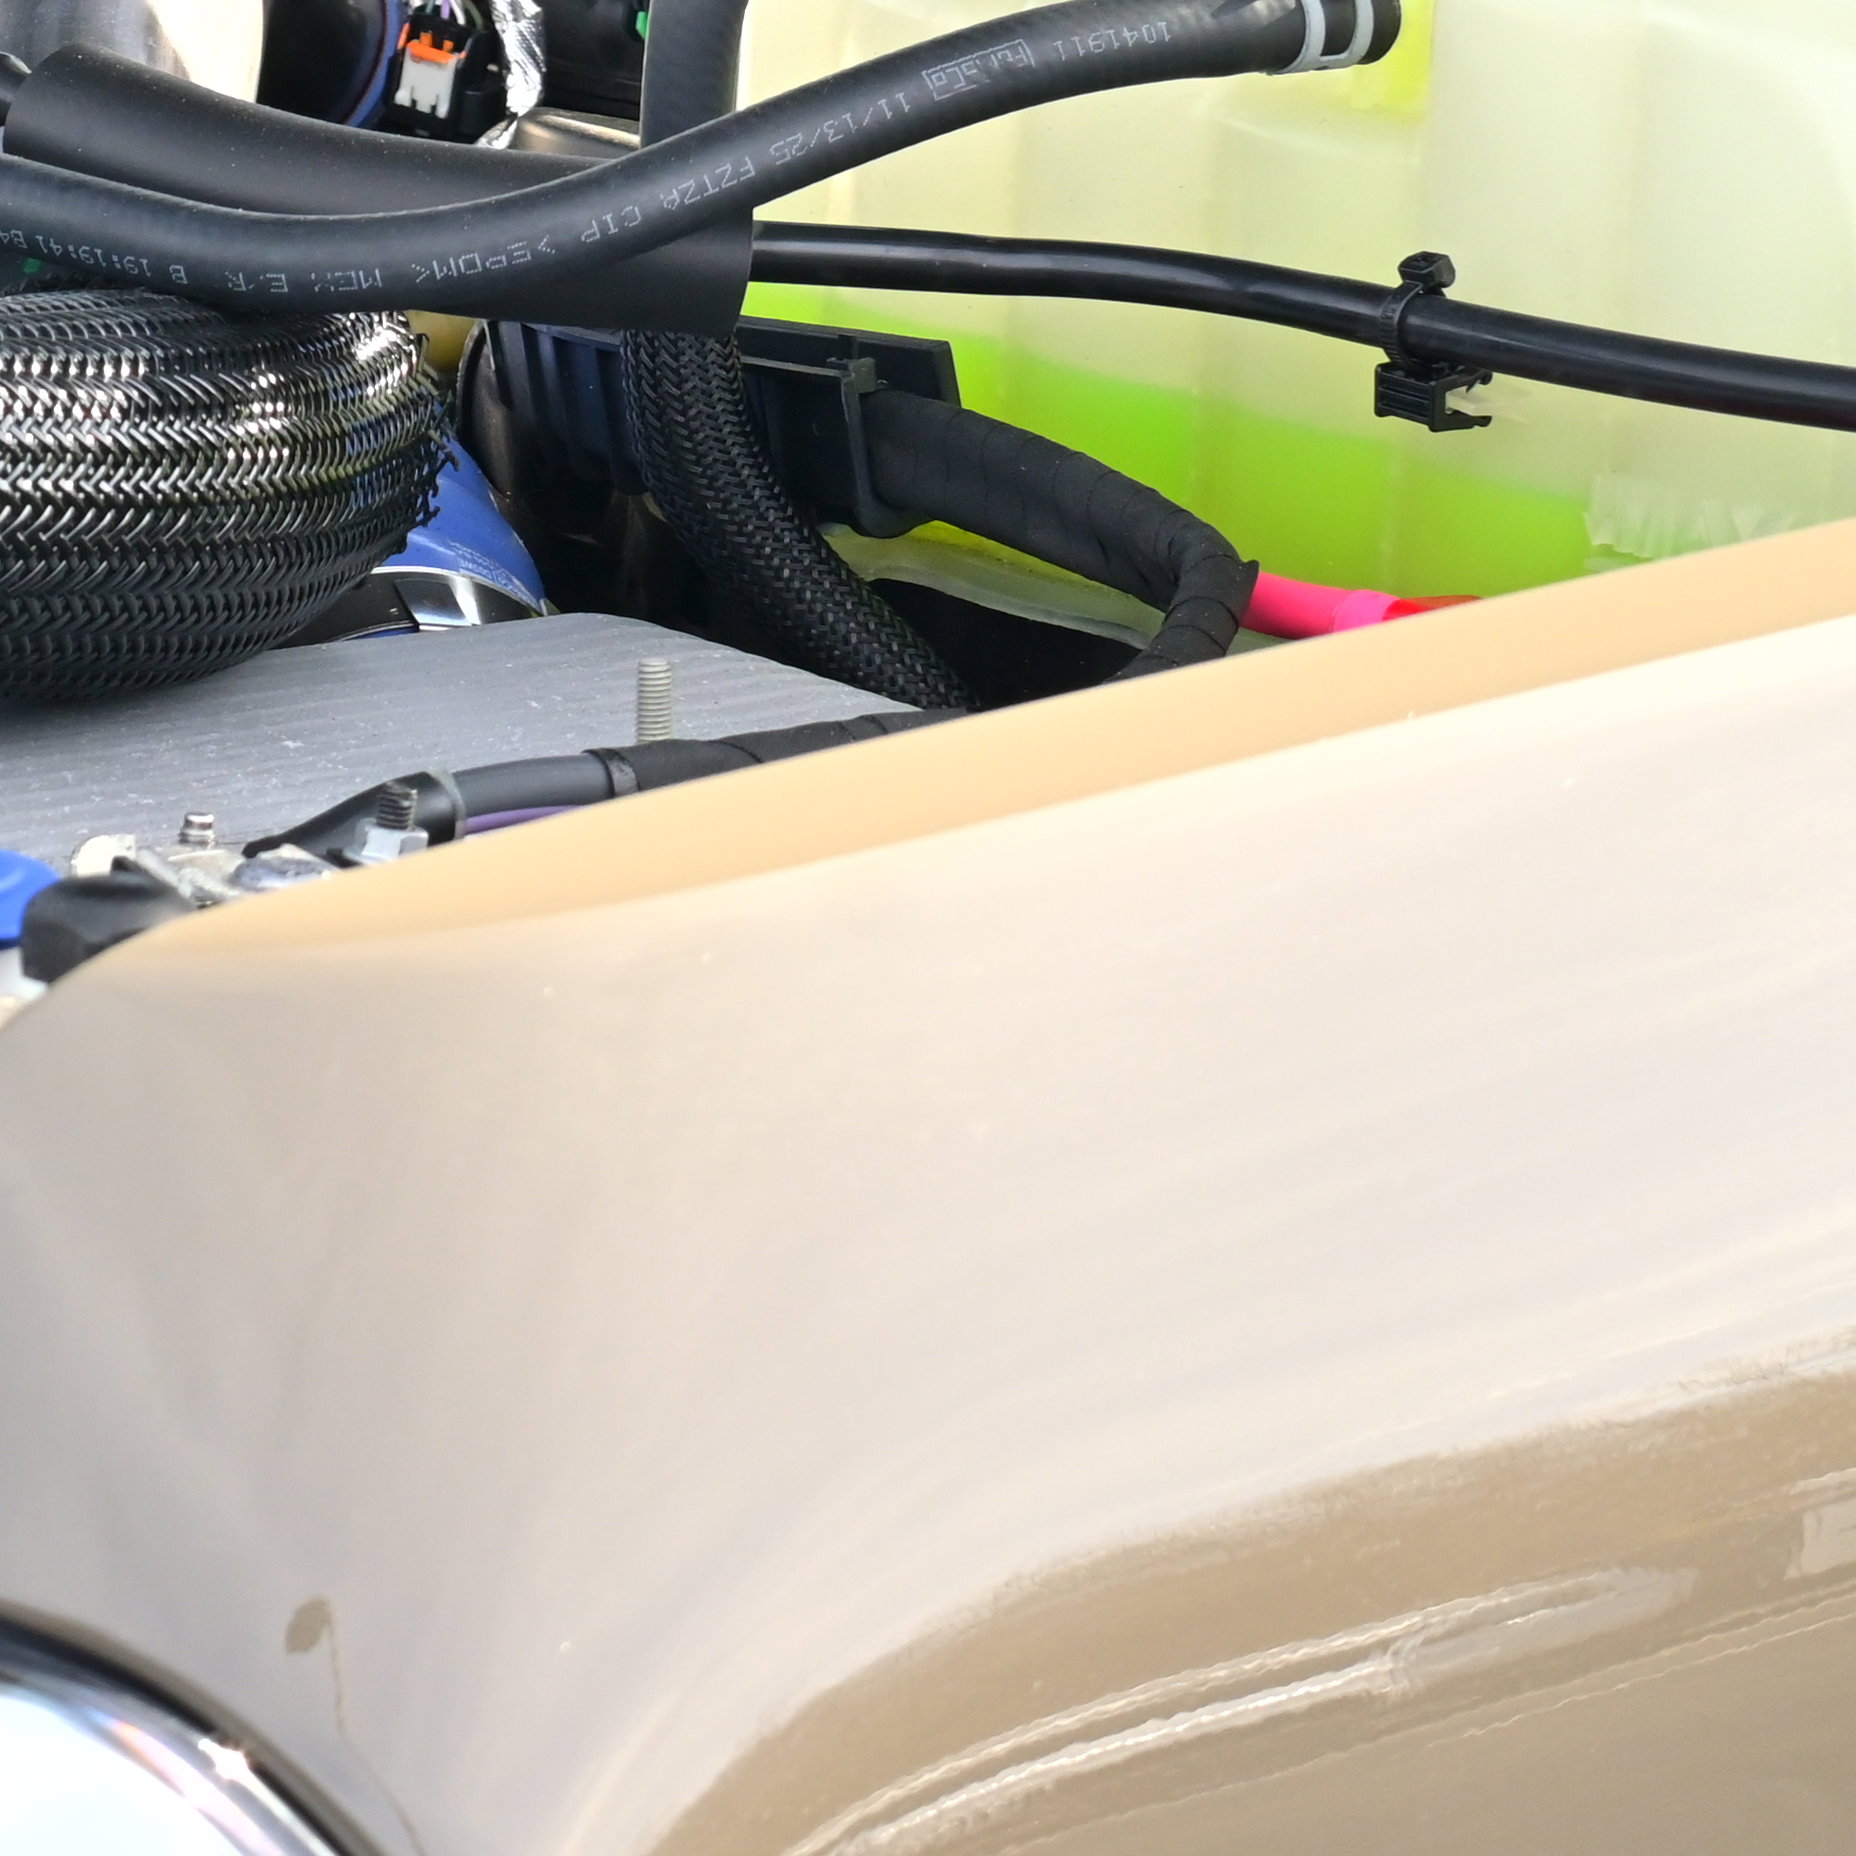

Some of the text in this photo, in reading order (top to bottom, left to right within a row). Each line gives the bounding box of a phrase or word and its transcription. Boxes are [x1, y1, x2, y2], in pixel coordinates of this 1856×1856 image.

[1054, 19, 1172, 63] 1041911
[769, 91, 912, 166] 11/13/25
[661, 156, 755, 211] FZTZA
[579, 203, 643, 244] CIP
[34, 233, 154, 278] 19:19:41
